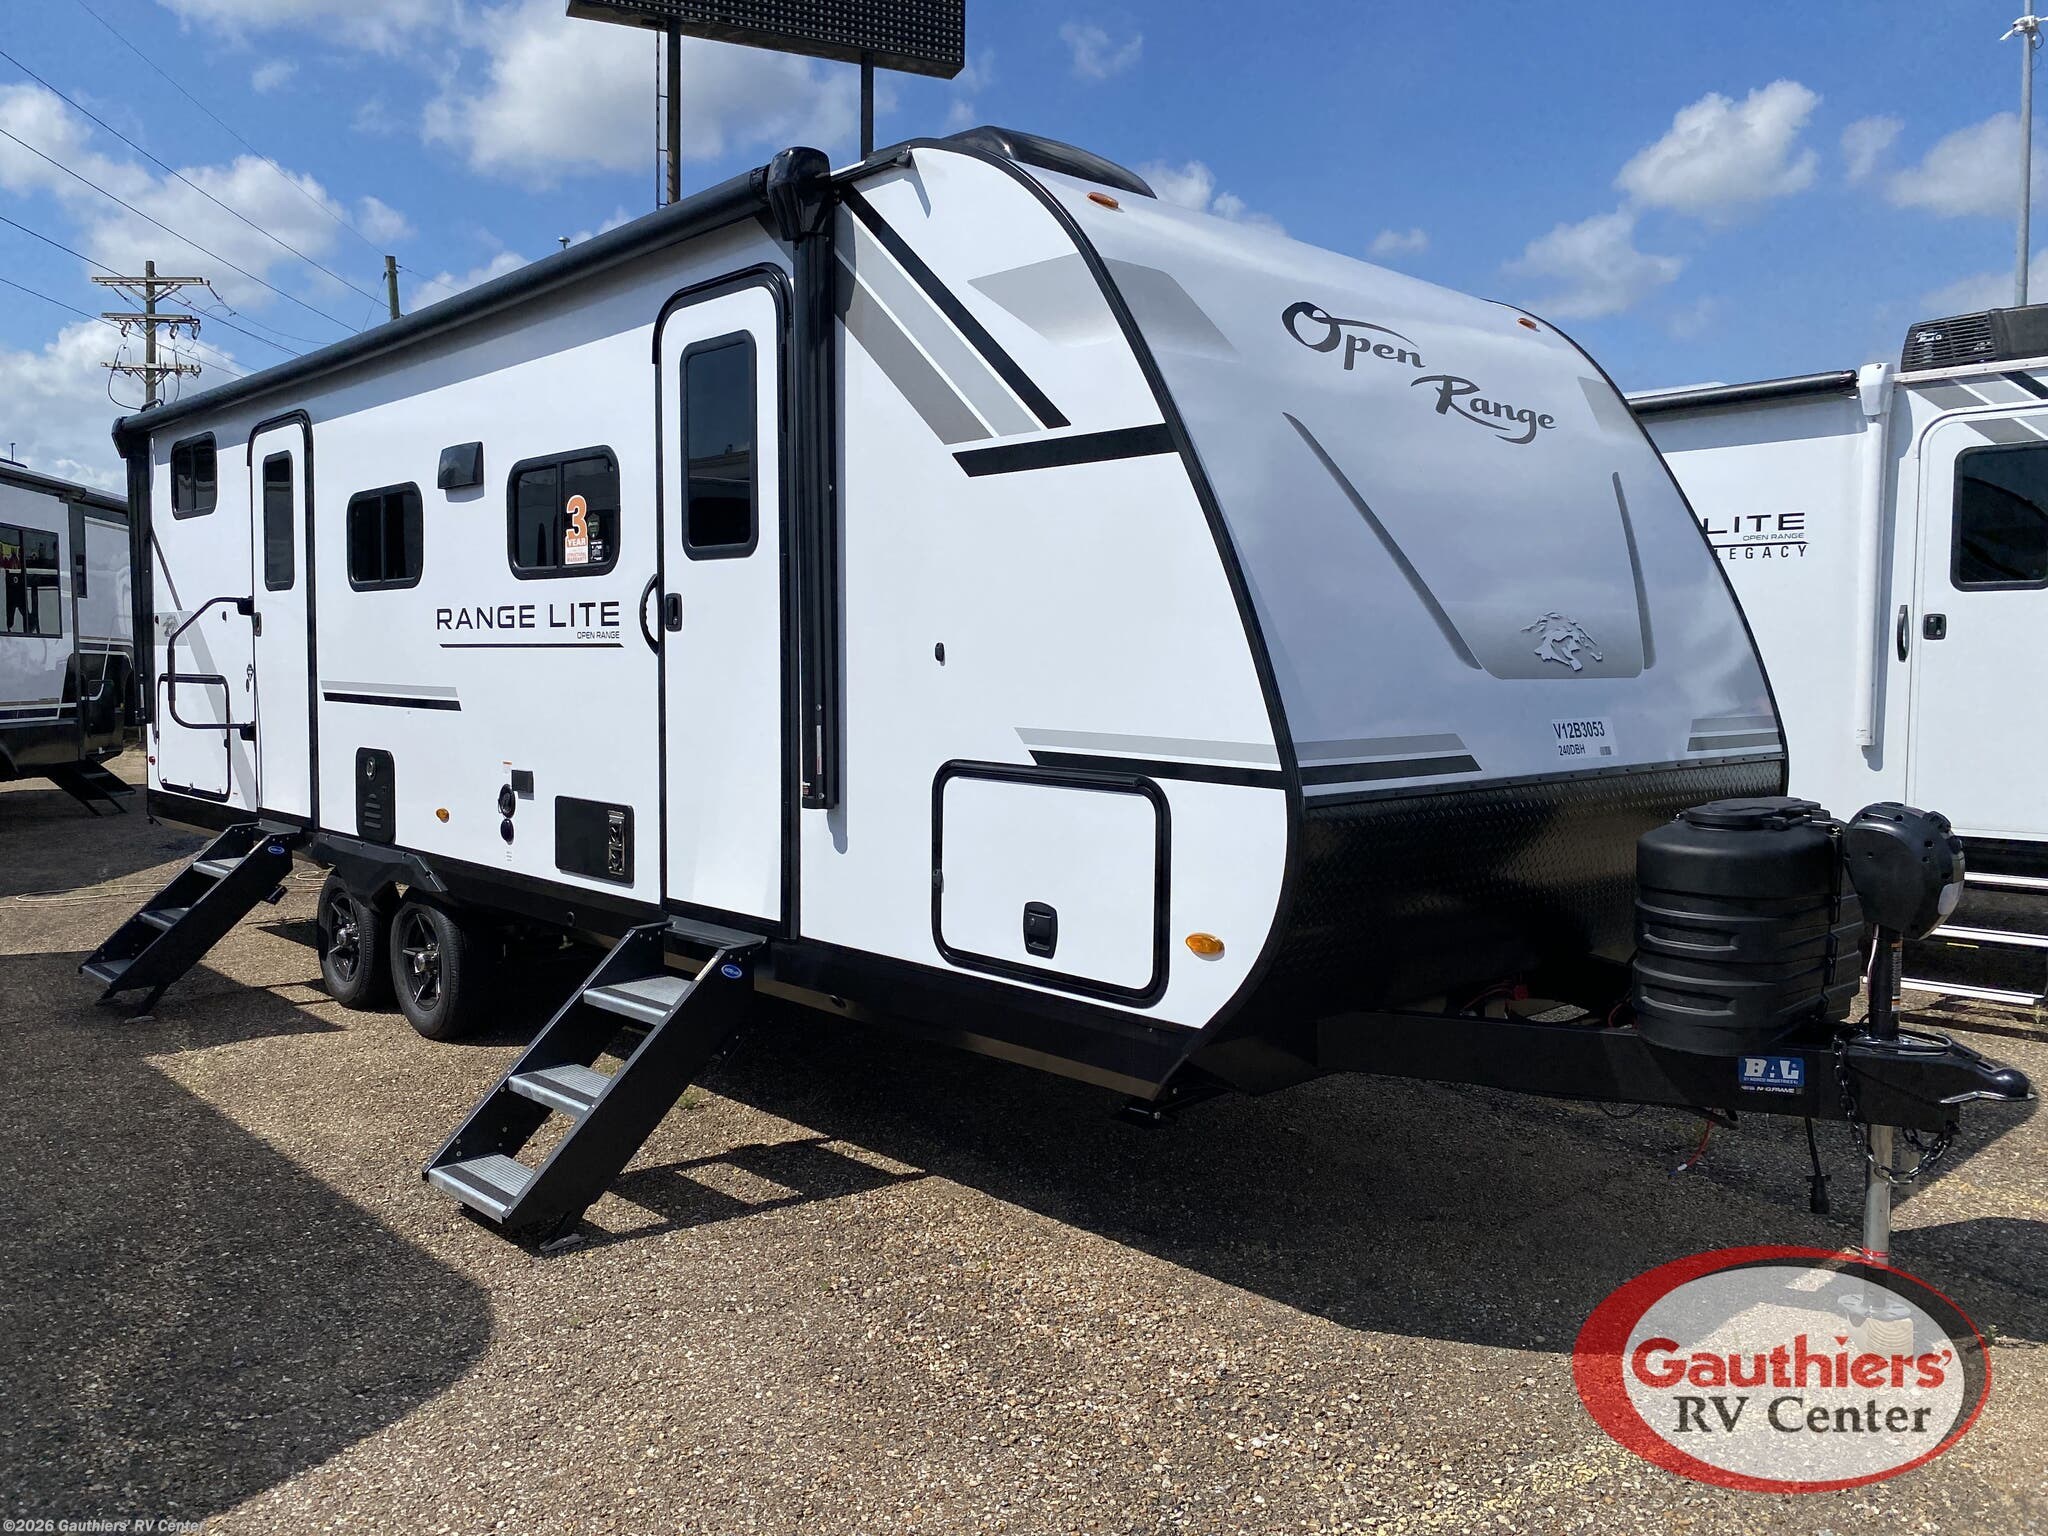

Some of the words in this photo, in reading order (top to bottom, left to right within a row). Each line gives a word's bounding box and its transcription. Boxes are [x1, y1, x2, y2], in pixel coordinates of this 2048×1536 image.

[1281, 301, 1425, 370] Open
[1410, 374, 1555, 444] Range
[566, 495, 587, 539] 3
[1703, 512, 1805, 534] LITE
[567, 538, 587, 547] YEAR
[1770, 532, 1804, 540] RANGE
[436, 605, 536, 630] RANGE
[549, 601, 620, 627] LITE
[577, 632, 595, 640] OPEN
[596, 631, 620, 639] RANGE
[1553, 721, 1605, 739] V12B3053
[1558, 744, 1586, 756] 240DBH
[1744, 1058, 1799, 1080] BAL
